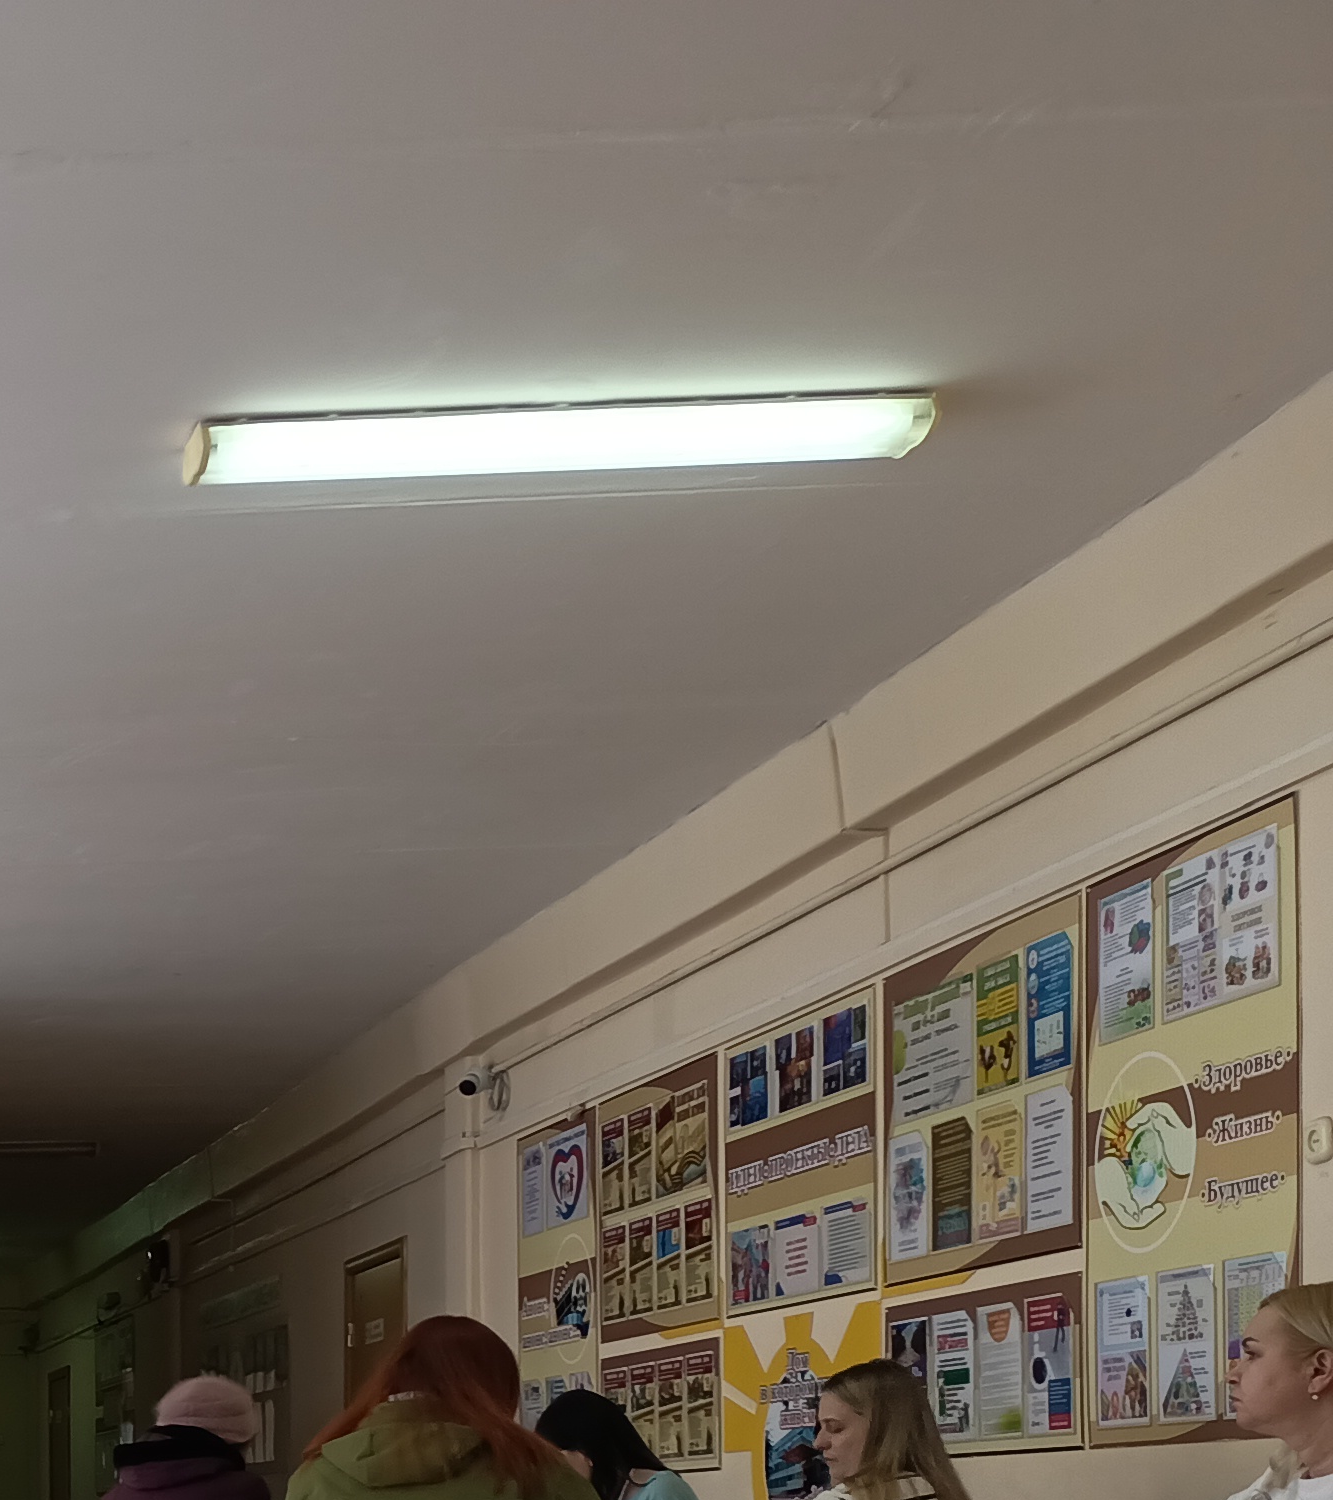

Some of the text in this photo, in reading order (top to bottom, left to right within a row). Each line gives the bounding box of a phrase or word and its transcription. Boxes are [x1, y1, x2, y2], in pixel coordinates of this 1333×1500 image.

[1202, 1050, 1283, 1089] Здоровье
[1214, 1115, 1274, 1144] Жизнь
[1206, 1173, 1279, 1209] Будущее
